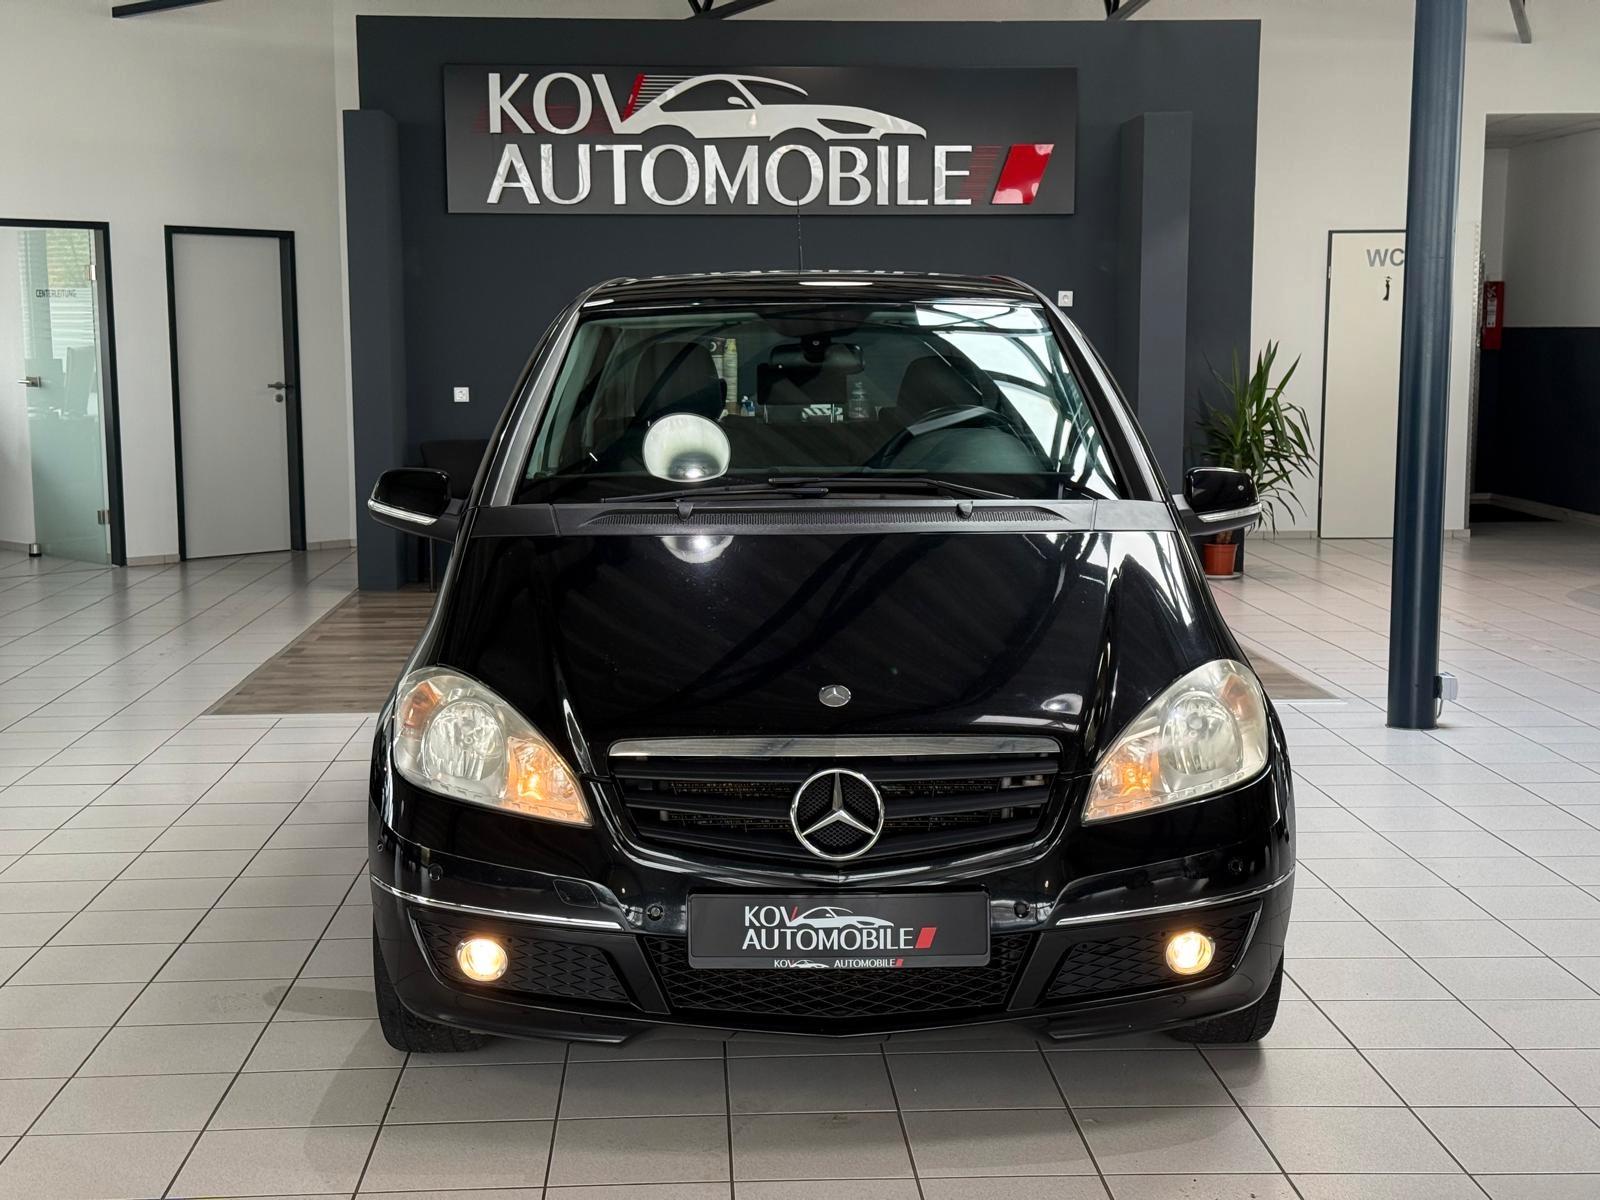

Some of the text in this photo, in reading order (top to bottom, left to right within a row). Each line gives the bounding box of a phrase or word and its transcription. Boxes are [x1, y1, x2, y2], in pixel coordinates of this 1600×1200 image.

[488, 72, 645, 134] KOV
[486, 144, 972, 206] AUTOMOBILE
[1366, 248, 1404, 267] WC
[744, 906, 798, 927] KOV
[742, 928, 914, 950] AUTOMOBILE
[774, 959, 896, 968] KOV AUTOMOBILE
